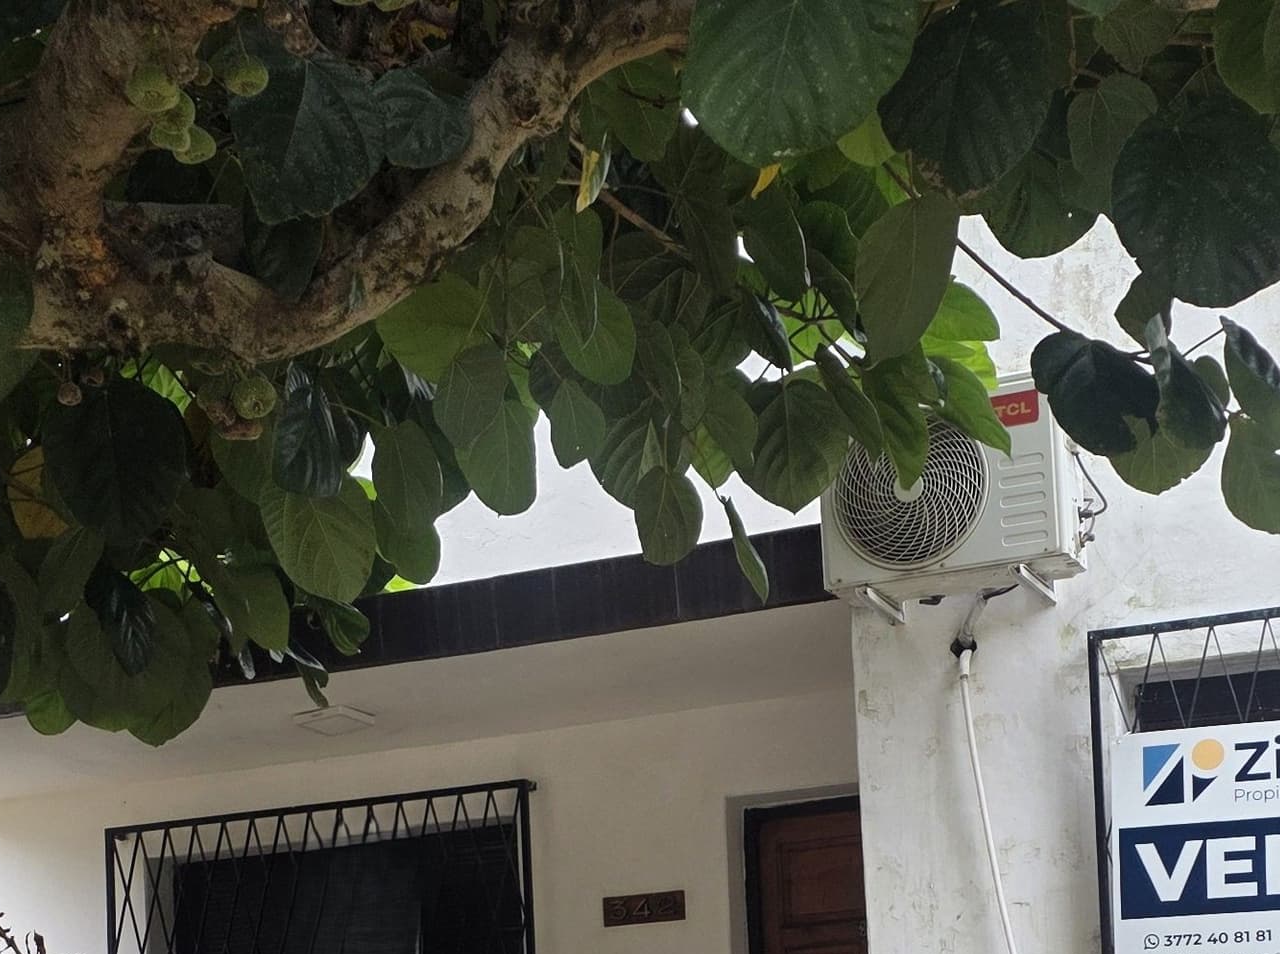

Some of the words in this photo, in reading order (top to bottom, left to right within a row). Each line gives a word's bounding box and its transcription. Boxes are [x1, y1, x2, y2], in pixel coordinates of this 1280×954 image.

[993, 401, 1032, 418] TCL
[607, 896, 676, 921] 342
[1163, 933, 1203, 947] 3772
[1207, 932, 1229, 945] 40
[1234, 930, 1250, 943] 81
[1255, 929, 1272, 942] 81
